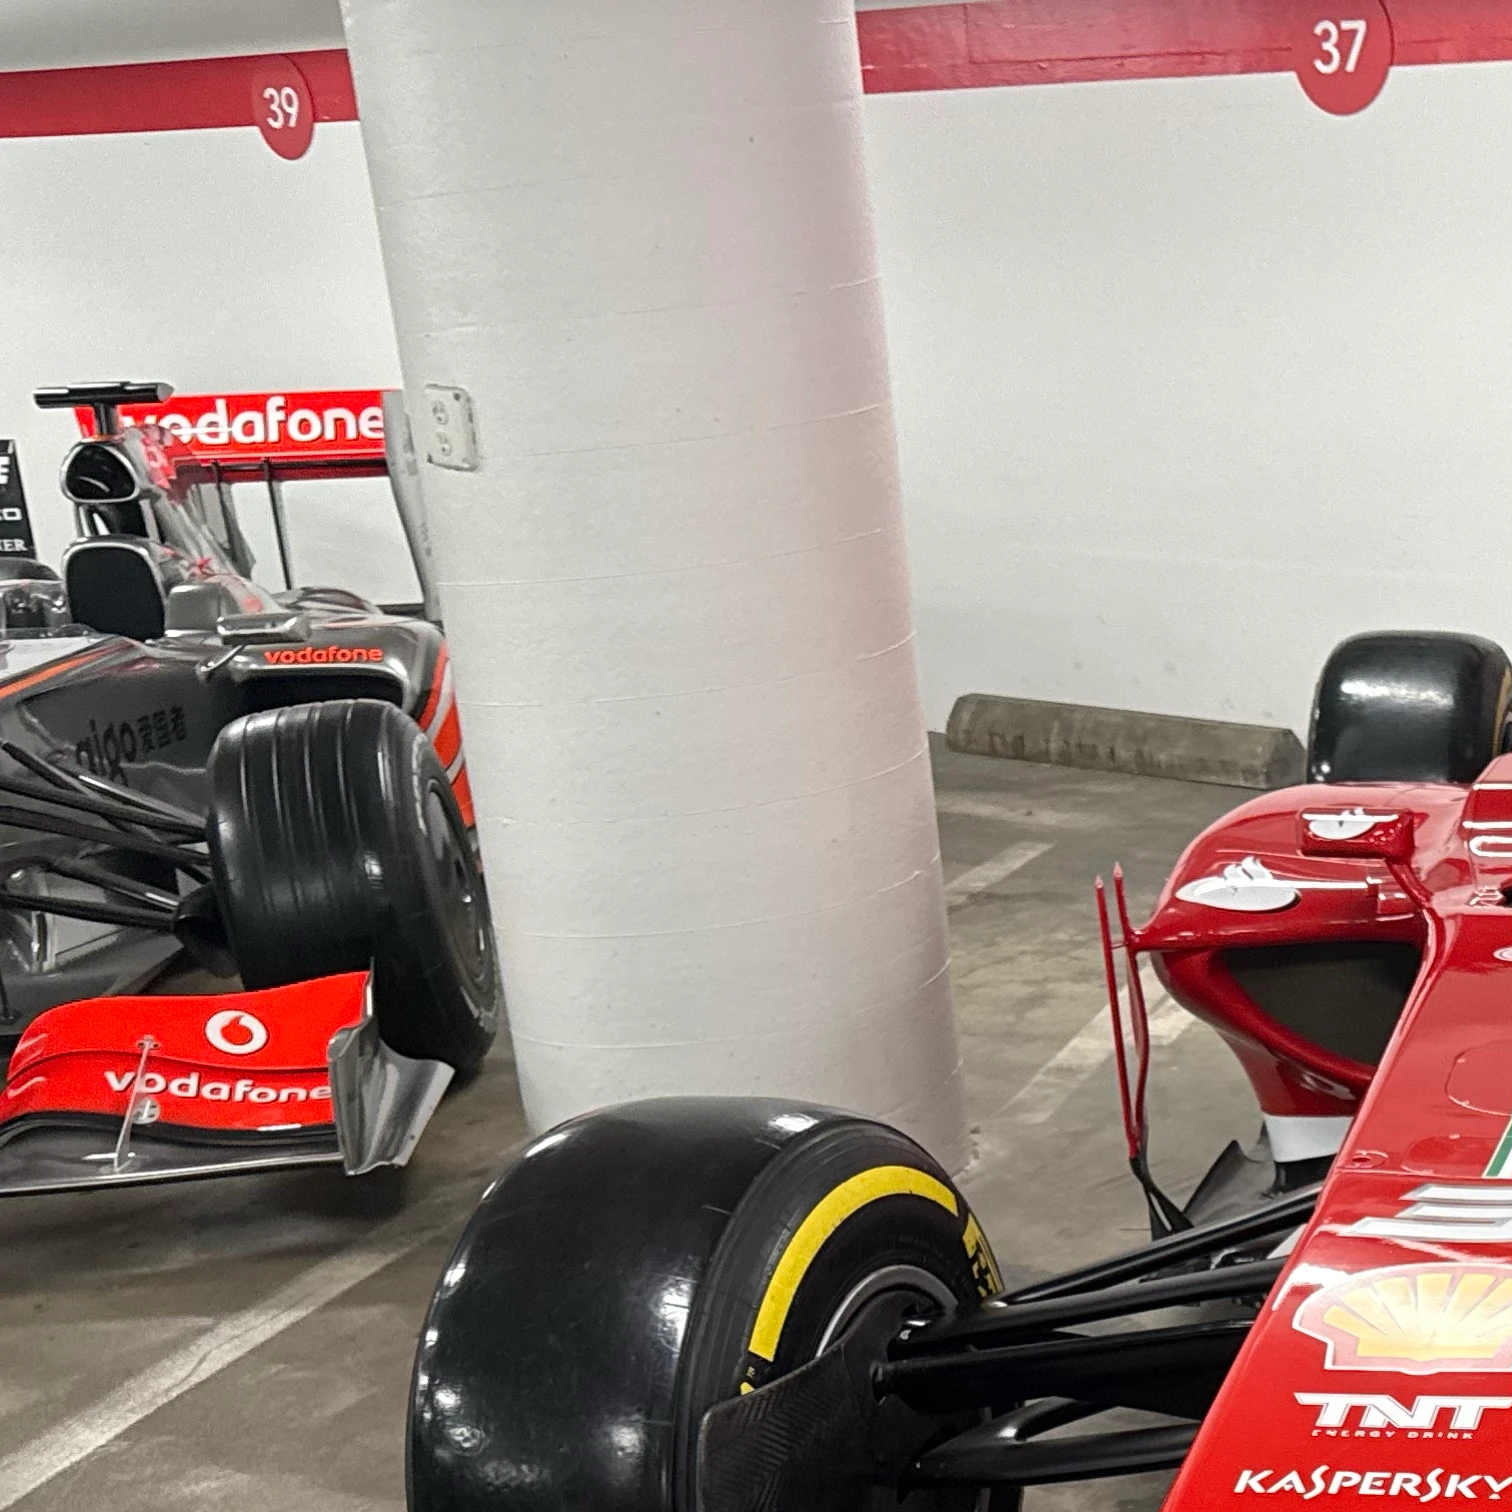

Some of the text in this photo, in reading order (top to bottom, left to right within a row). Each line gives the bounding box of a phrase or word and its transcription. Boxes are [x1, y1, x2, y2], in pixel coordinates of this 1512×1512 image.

[1313, 19, 1368, 75] 37
[262, 87, 300, 128] 39
[264, 645, 383, 664] vodafone
[104, 1071, 332, 1103] vodafone
[1310, 1429, 1474, 1440] ENERGY DRINK
